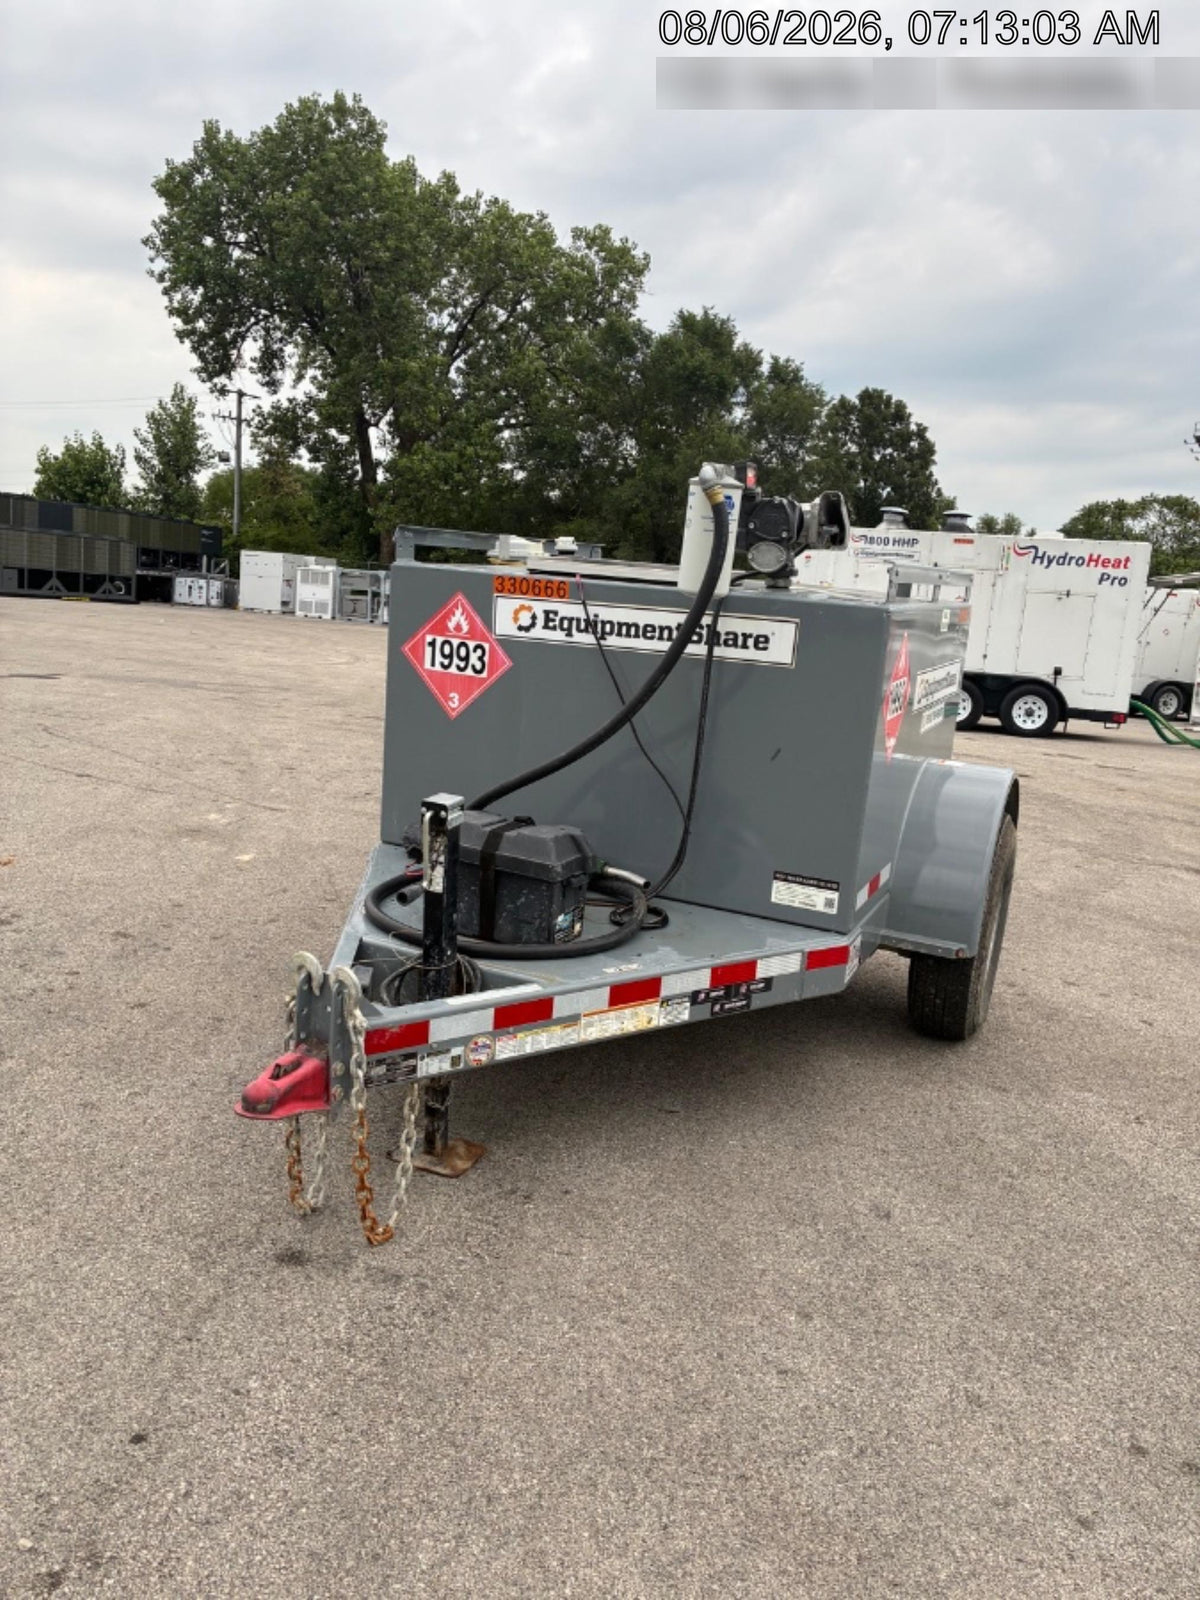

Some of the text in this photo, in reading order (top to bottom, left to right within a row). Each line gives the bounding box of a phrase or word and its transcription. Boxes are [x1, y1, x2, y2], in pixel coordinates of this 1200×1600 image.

[892, 537, 920, 548] HHP
[1031, 547, 1131, 570] HydroHeat
[494, 575, 568, 599] 330666
[1098, 571, 1128, 587] Pro
[427, 637, 487, 675] 1993
[447, 692, 460, 709] 3
